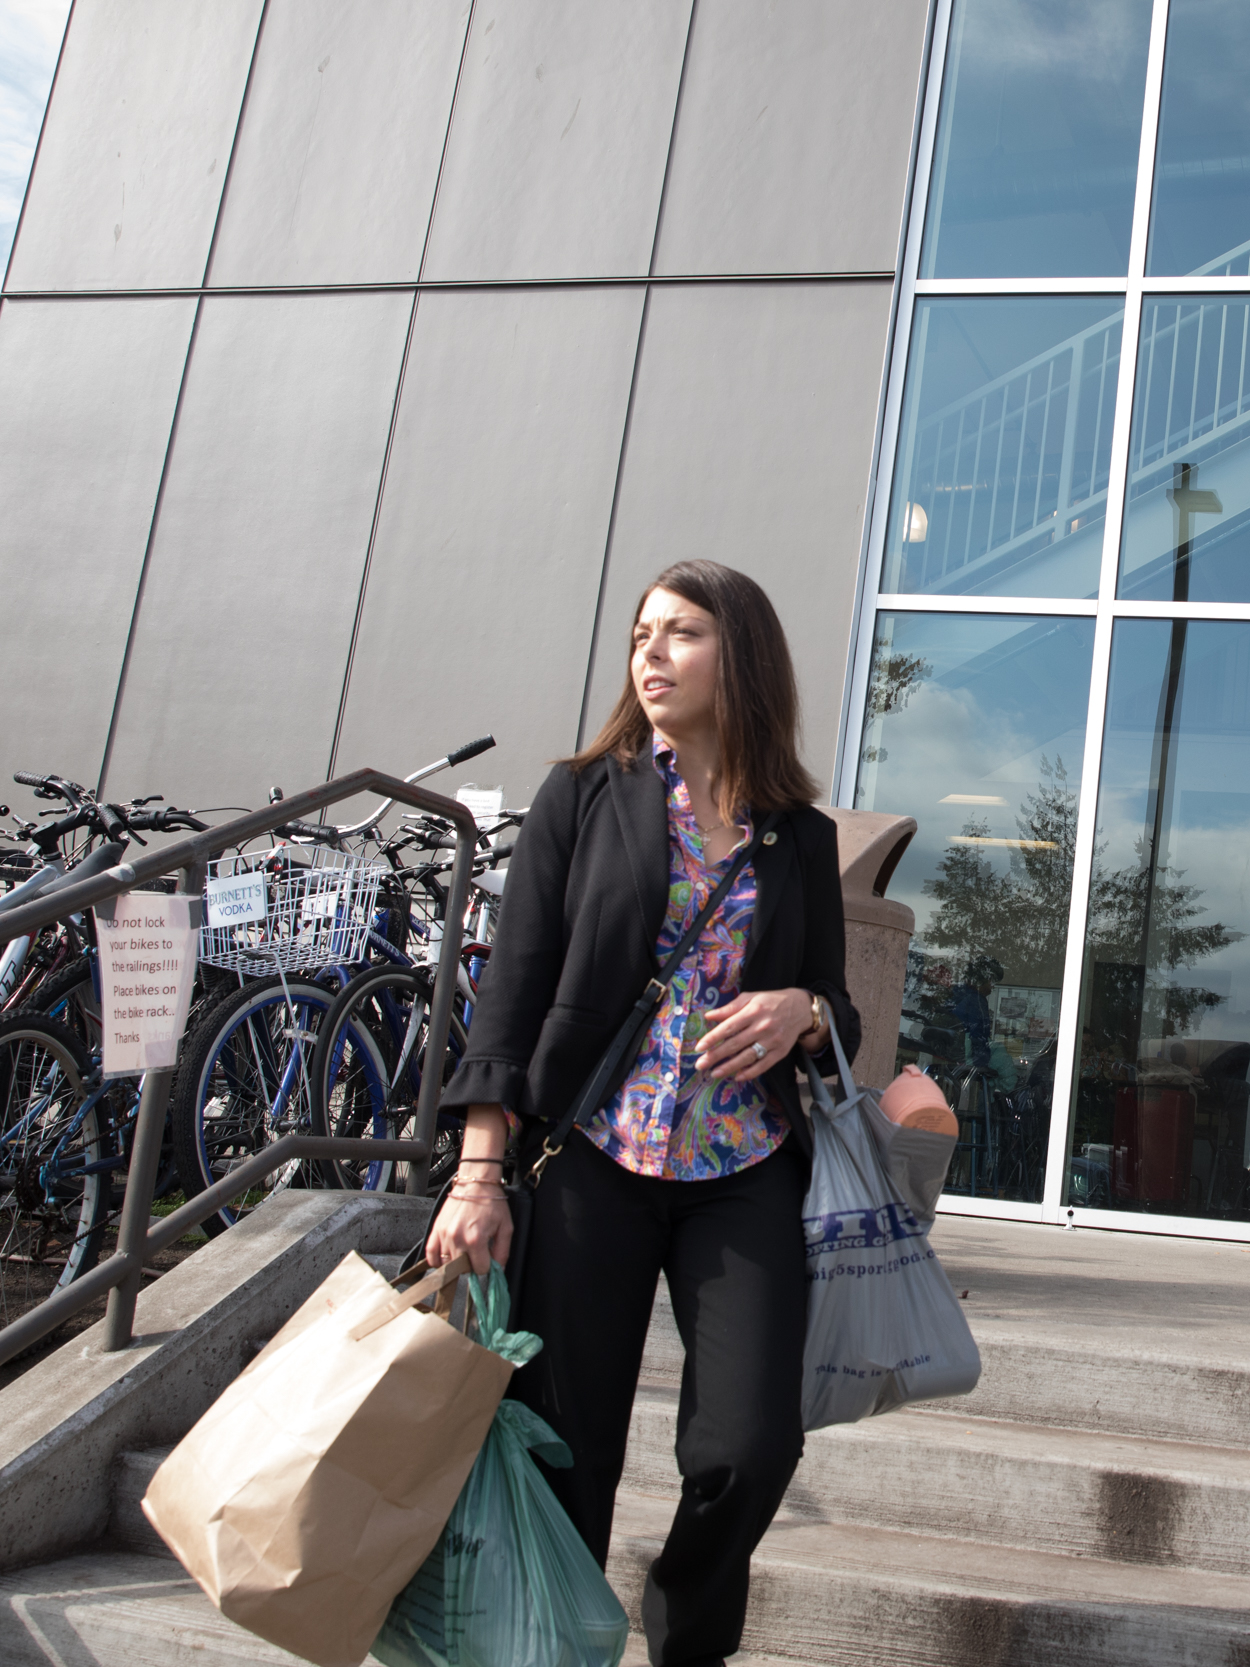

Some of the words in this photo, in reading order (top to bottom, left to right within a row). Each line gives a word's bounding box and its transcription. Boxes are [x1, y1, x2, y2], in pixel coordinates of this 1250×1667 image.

[209, 883, 263, 906] BURNETT'S
[218, 902, 253, 917] VODKA
[122, 918, 142, 928] not
[144, 916, 166, 928] lock
[109, 940, 127, 952] your
[130, 938, 160, 950] bikes
[162, 939, 173, 949] to
[111, 960, 125, 972] the
[126, 959, 179, 974] railings!!!!
[113, 985, 134, 997] Place
[135, 984, 160, 996] bikes
[162, 986, 177, 995] on
[113, 1007, 125, 1019] the
[126, 1006, 144, 1018] bike
[146, 1005, 175, 1017] rack..
[114, 1032, 140, 1044] Thanks
[842, 1365, 867, 1379] bag
[870, 1367, 882, 1377] is
